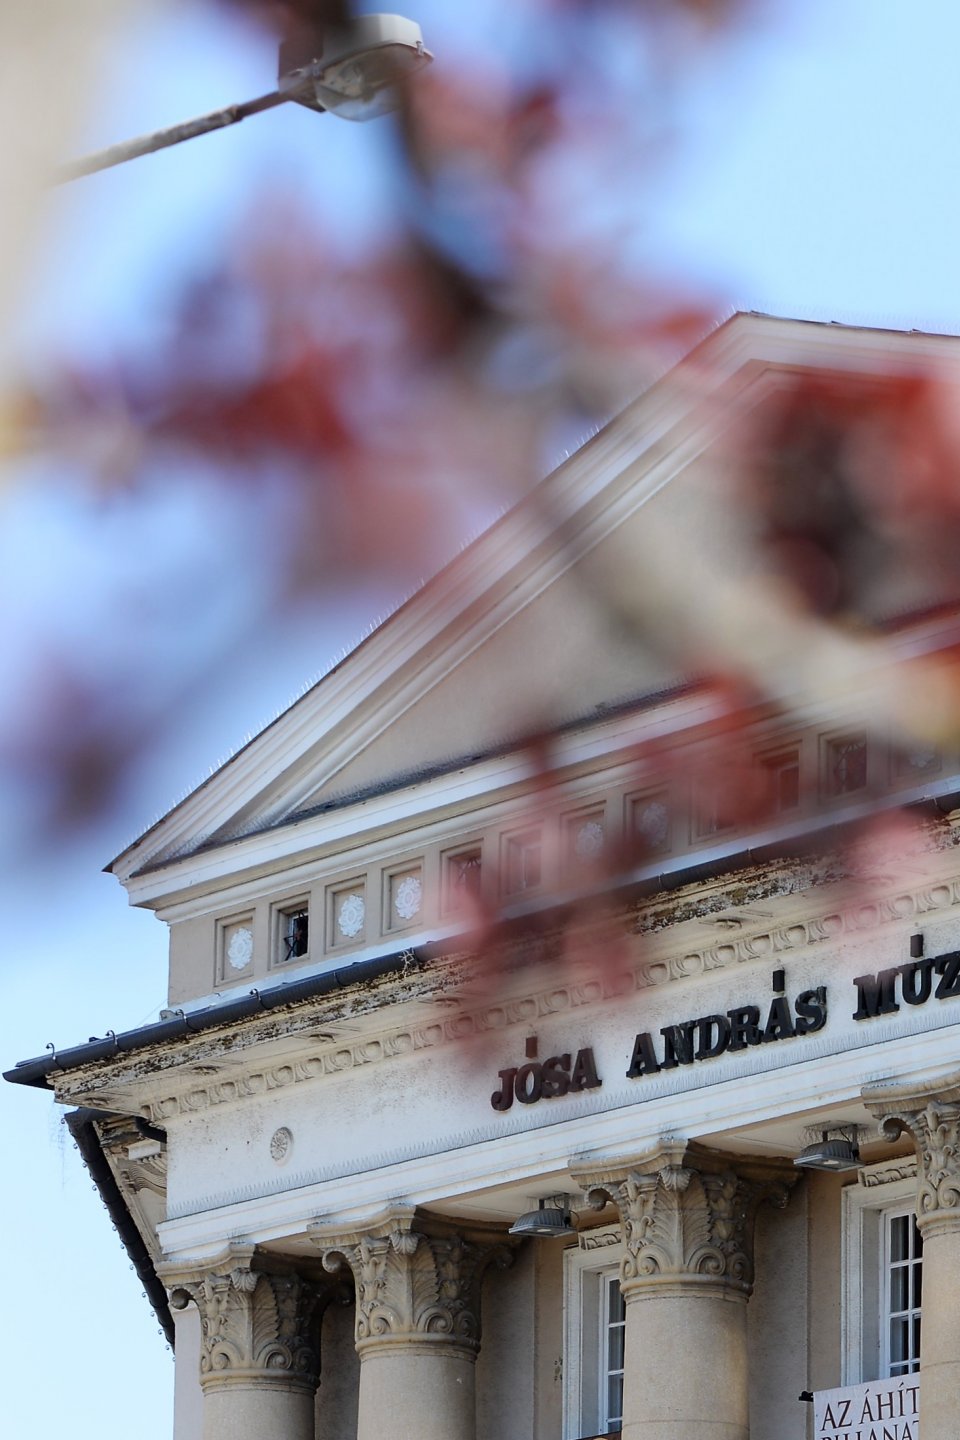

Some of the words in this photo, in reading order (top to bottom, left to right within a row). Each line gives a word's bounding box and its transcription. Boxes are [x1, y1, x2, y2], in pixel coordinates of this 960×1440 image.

[491, 1035, 602, 1111] JÓSA
[626, 970, 828, 1078] ANDRÁS
[820, 1399, 853, 1432] AZ
[859, 1382, 920, 1424] ÁHÍT
